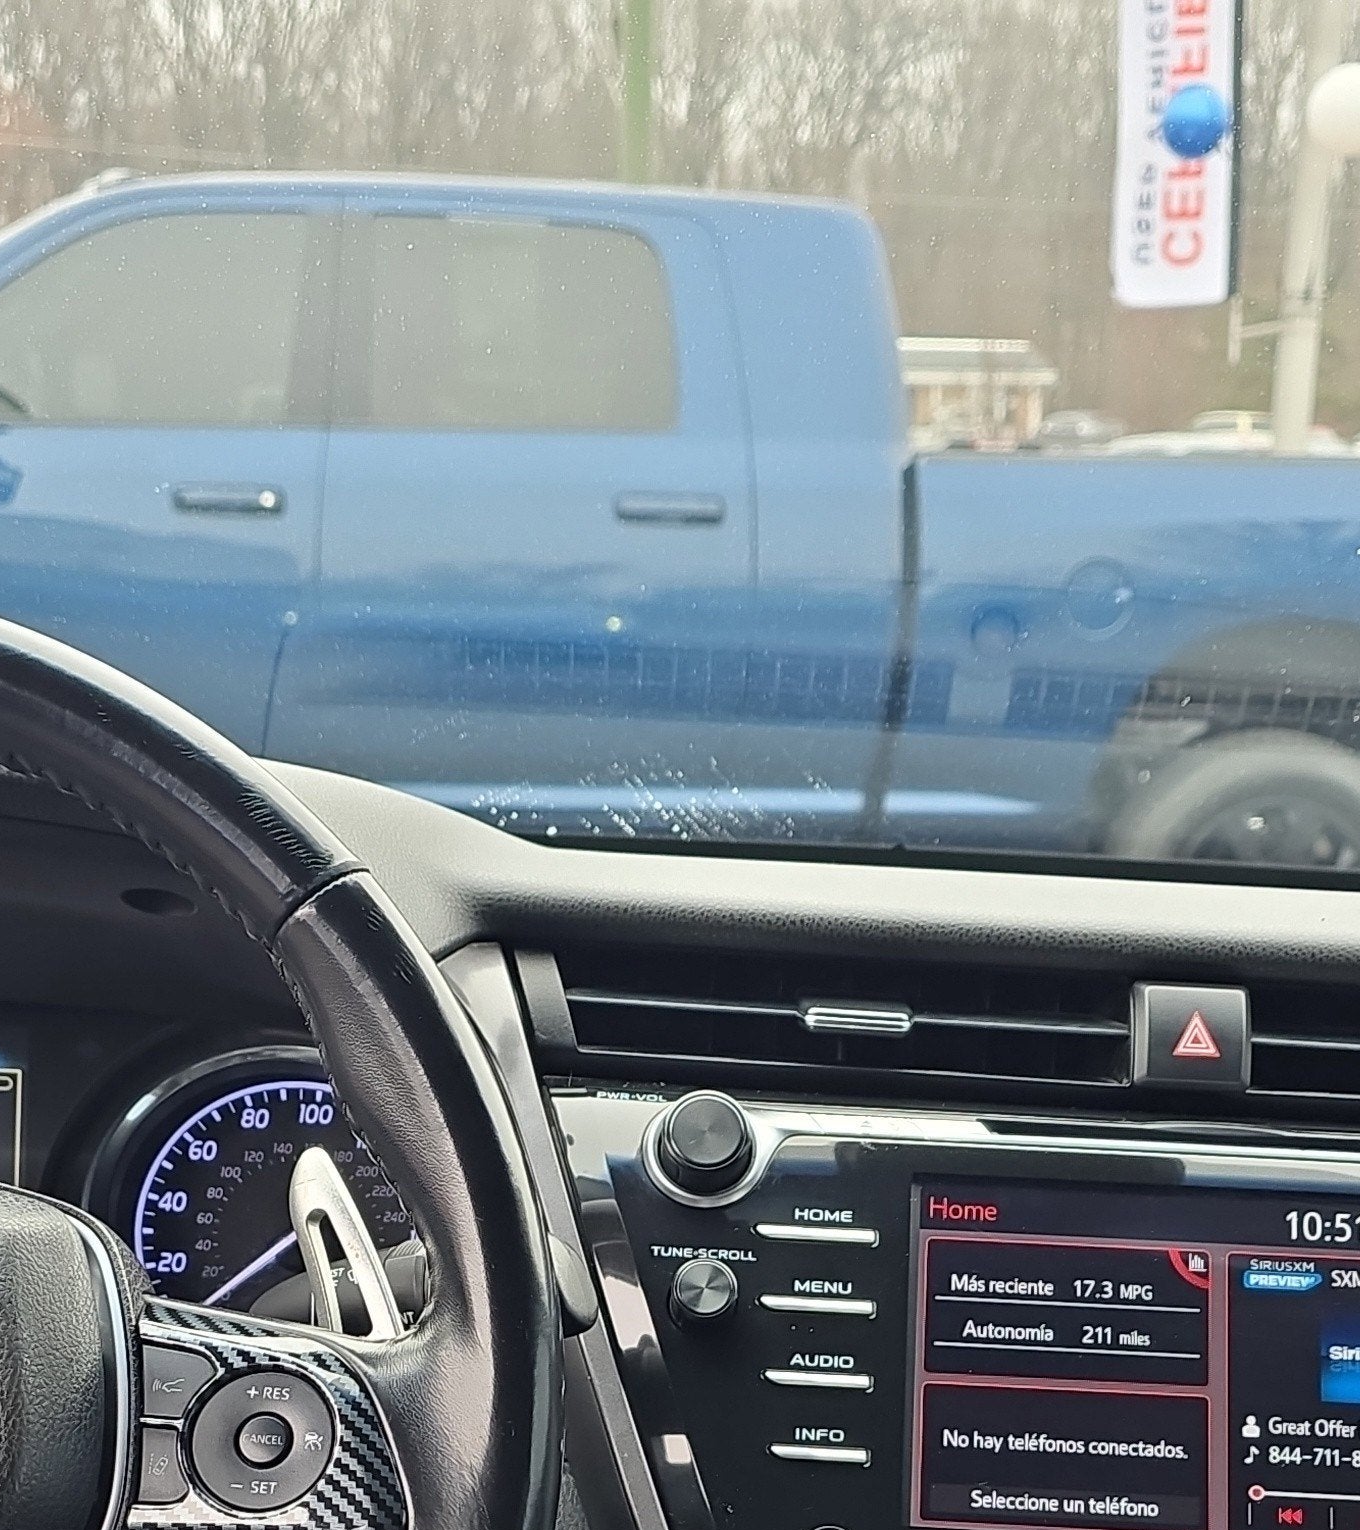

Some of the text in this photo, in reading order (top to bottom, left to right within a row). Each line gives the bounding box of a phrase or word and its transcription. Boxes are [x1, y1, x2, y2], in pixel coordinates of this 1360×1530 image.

[240, 1108, 271, 1129] 80
[298, 1103, 334, 1125] 100
[188, 1140, 218, 1161] 60
[244, 1150, 265, 1163] 120
[273, 1142, 293, 1155] 140
[220, 1166, 241, 1179] 100
[355, 1166, 378, 1177] 200
[206, 1187, 224, 1199] 80
[371, 1185, 394, 1197] 220
[157, 1191, 188, 1213] 40
[929, 1196, 998, 1222] Home
[196, 1212, 213, 1225] 60
[382, 1211, 406, 1223] 240
[793, 1208, 854, 1224] HOME
[195, 1239, 211, 1251] 40
[156, 1252, 187, 1273] 20
[202, 1264, 219, 1278] 20
[793, 1279, 853, 1295] MENU
[950, 1273, 1154, 1301] Más reciente 17.3 MPG
[1248, 1275, 1316, 1289] PREVIEW
[962, 1319, 1152, 1347] Autonomía 211 miles
[789, 1353, 855, 1369] AUDIO
[793, 1426, 845, 1443] INFO
[1267, 1416, 1311, 1437] Great
[1314, 1418, 1357, 1440] Offer
[241, 1432, 285, 1447] CANCEL
[942, 1428, 1189, 1460] No hay teléfonos conectados.
[969, 1489, 1160, 1518] Seleccione un teléfono
